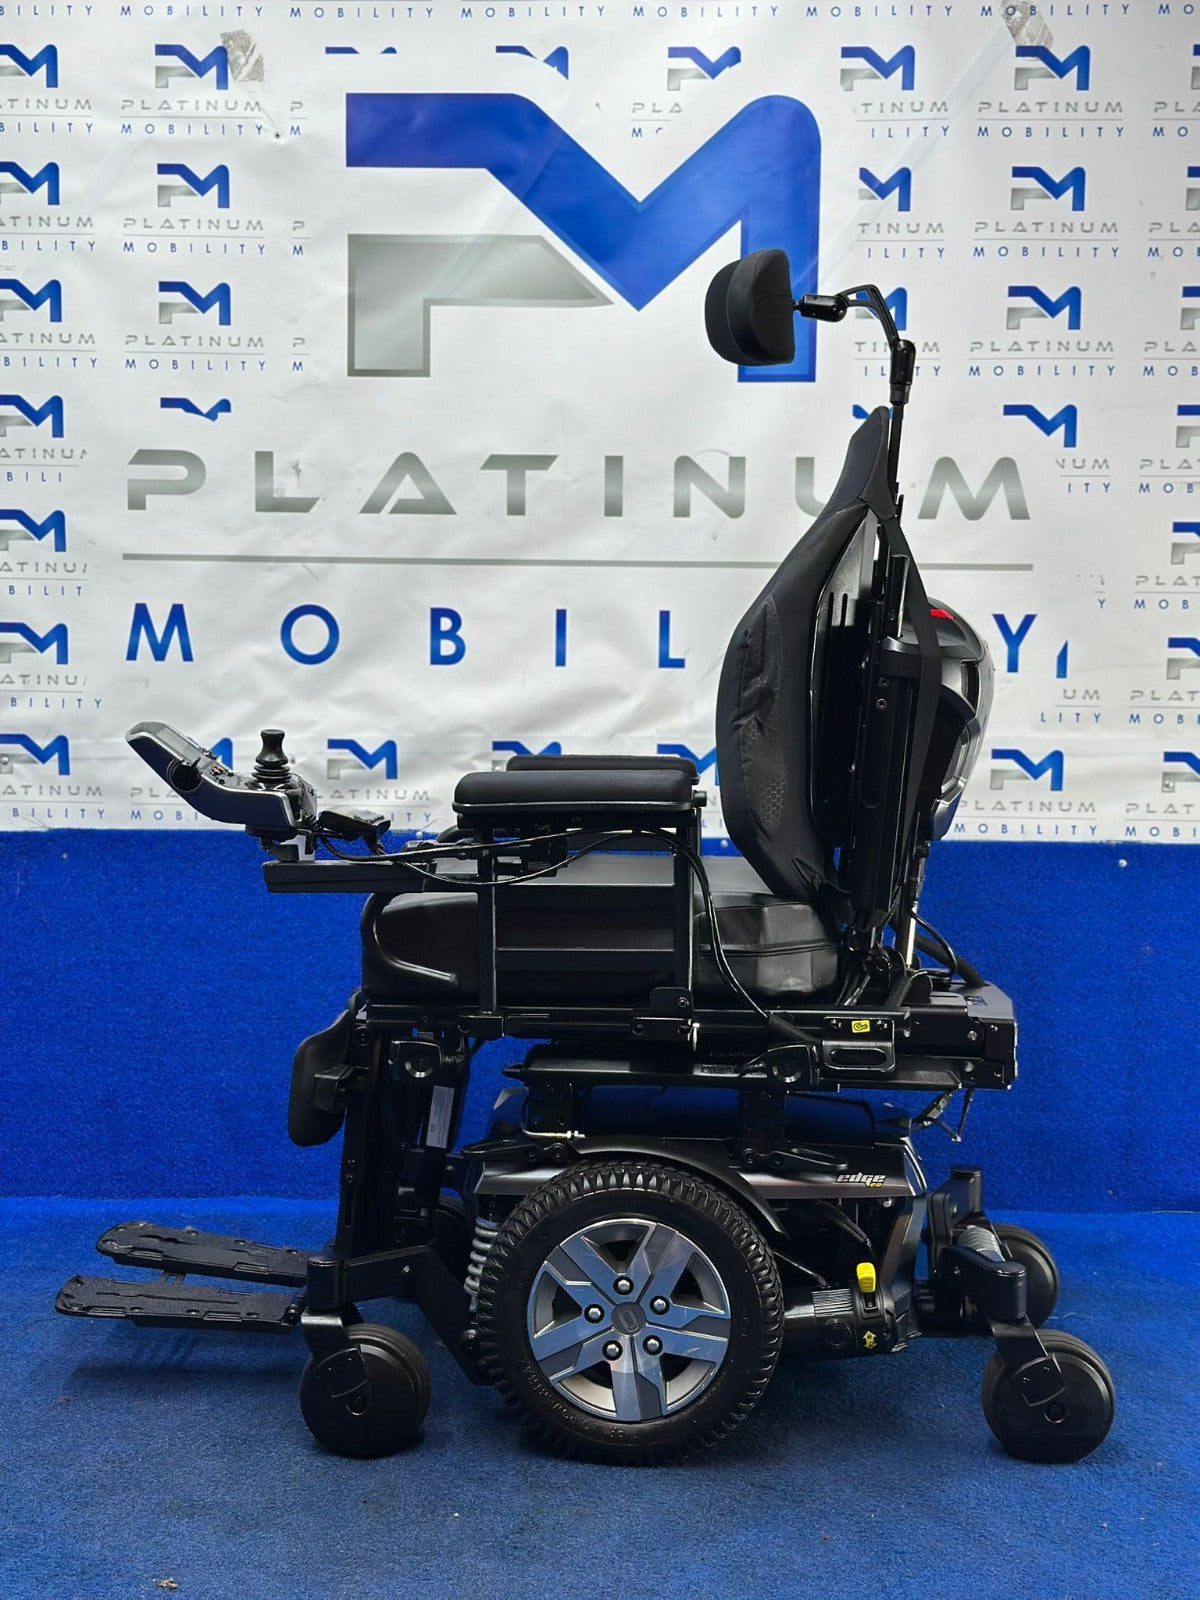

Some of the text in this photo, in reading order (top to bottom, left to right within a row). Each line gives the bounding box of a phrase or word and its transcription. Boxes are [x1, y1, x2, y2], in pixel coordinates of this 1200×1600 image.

[120, 5, 262, 17] MOBILITY
[290, 7, 433, 18] MOBILITY
[461, 6, 604, 18] MOBILITY
[633, 6, 778, 17] MOBILITY
[806, 5, 952, 17] MOBILITY
[980, 4, 1130, 16] MOBILITY
[122, 100, 261, 111] PLATINUM
[854, 101, 948, 113] TINUM
[978, 102, 1123, 113] PLATINUM
[121, 124, 262, 135] MOBILITY
[977, 126, 1124, 137] MOBILITY
[124, 218, 263, 230] PLATINUM
[975, 222, 1118, 233] PLATINUM
[123, 242, 265, 254] MOBILITY
[973, 246, 1119, 257] MOBILITY
[125, 335, 263, 347] PLATINUM
[970, 341, 1113, 352] PLATINUM
[125, 359, 265, 371] MOBILITY
[969, 365, 1115, 376] MOBILITY
[126, 602, 1037, 673] MOBILY
[954, 823, 1097, 835] MOBILITY
[837, 1171, 886, 1187] edge
